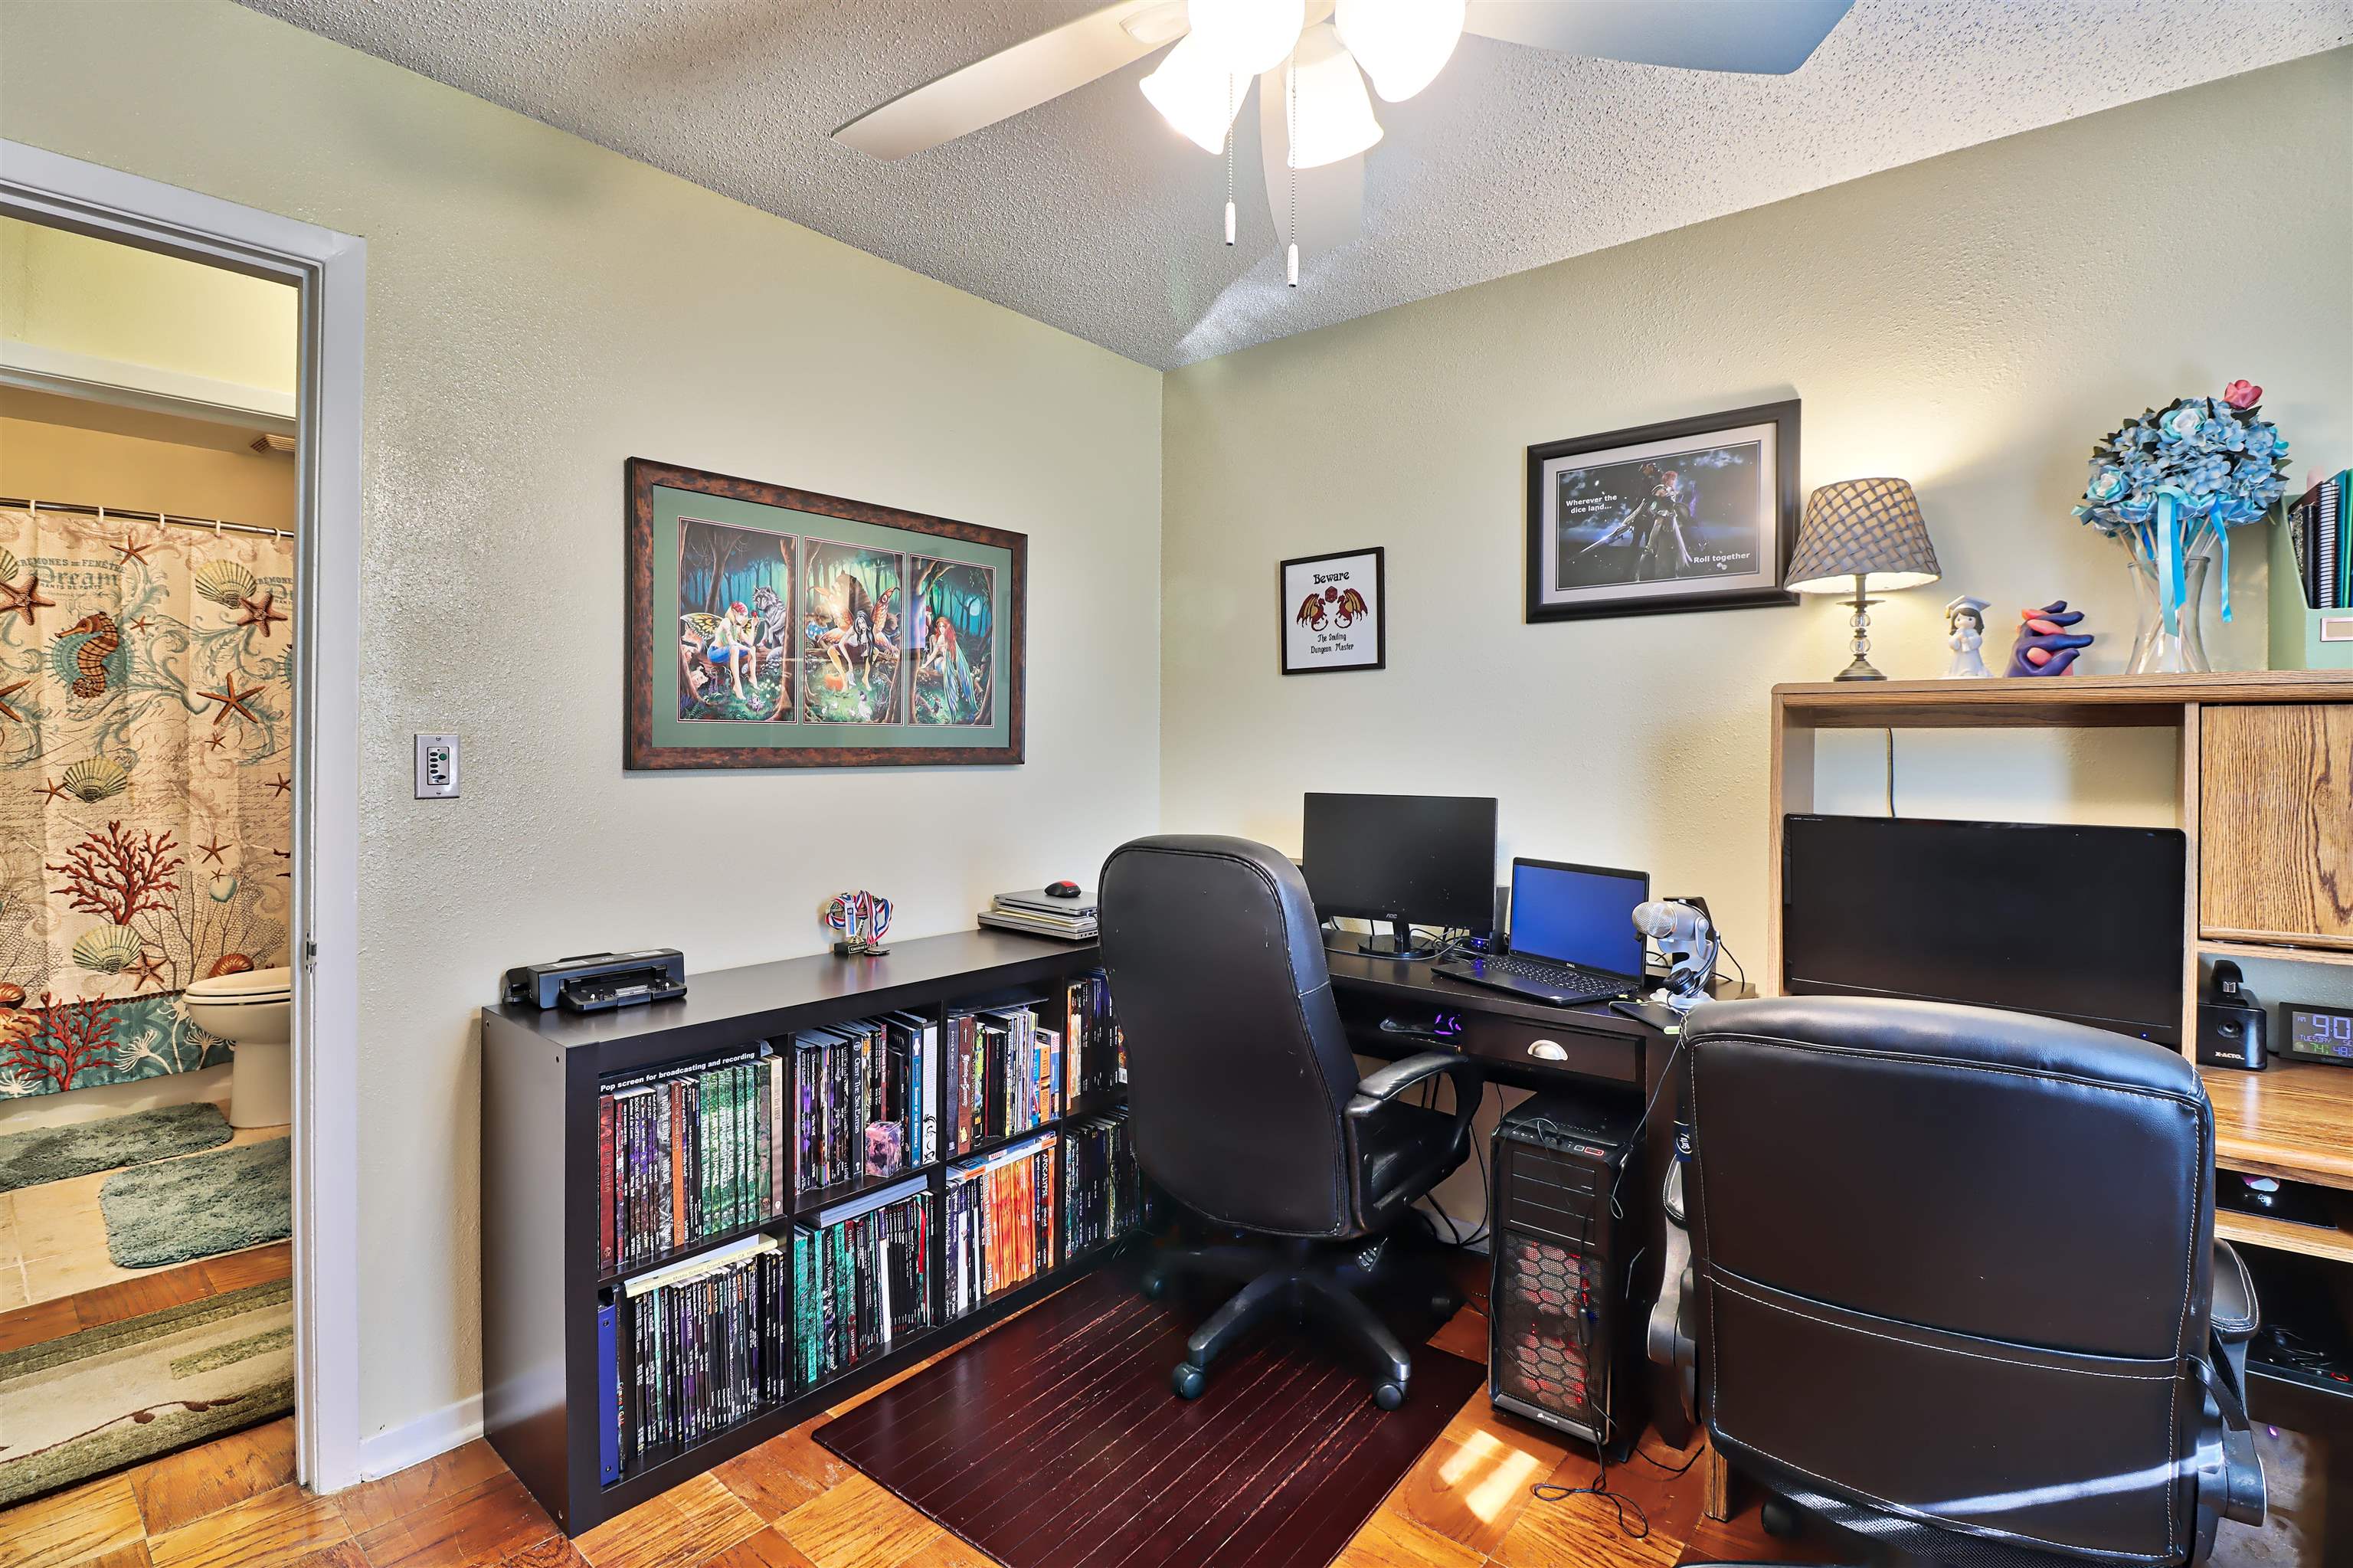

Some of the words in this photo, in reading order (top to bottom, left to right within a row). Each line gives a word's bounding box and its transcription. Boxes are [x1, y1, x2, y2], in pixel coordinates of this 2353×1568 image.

[1566, 497, 1602, 506] Wherever
[1570, 505, 1586, 513] dice
[1588, 503, 1612, 512] land...
[1694, 555, 1710, 564] Roll
[1712, 552, 1750, 564] together
[1313, 571, 1350, 584] Beware
[1317, 633, 1327, 643] The
[1329, 633, 1347, 641] Smiling
[1311, 646, 1331, 654] Dungeon
[1335, 643, 1354, 651] Master
[600, 1083, 615, 1092] Pop
[617, 1078, 644, 1087] screen
[659, 1063, 706, 1079] broadcasting
[722, 1052, 755, 1064] recording
